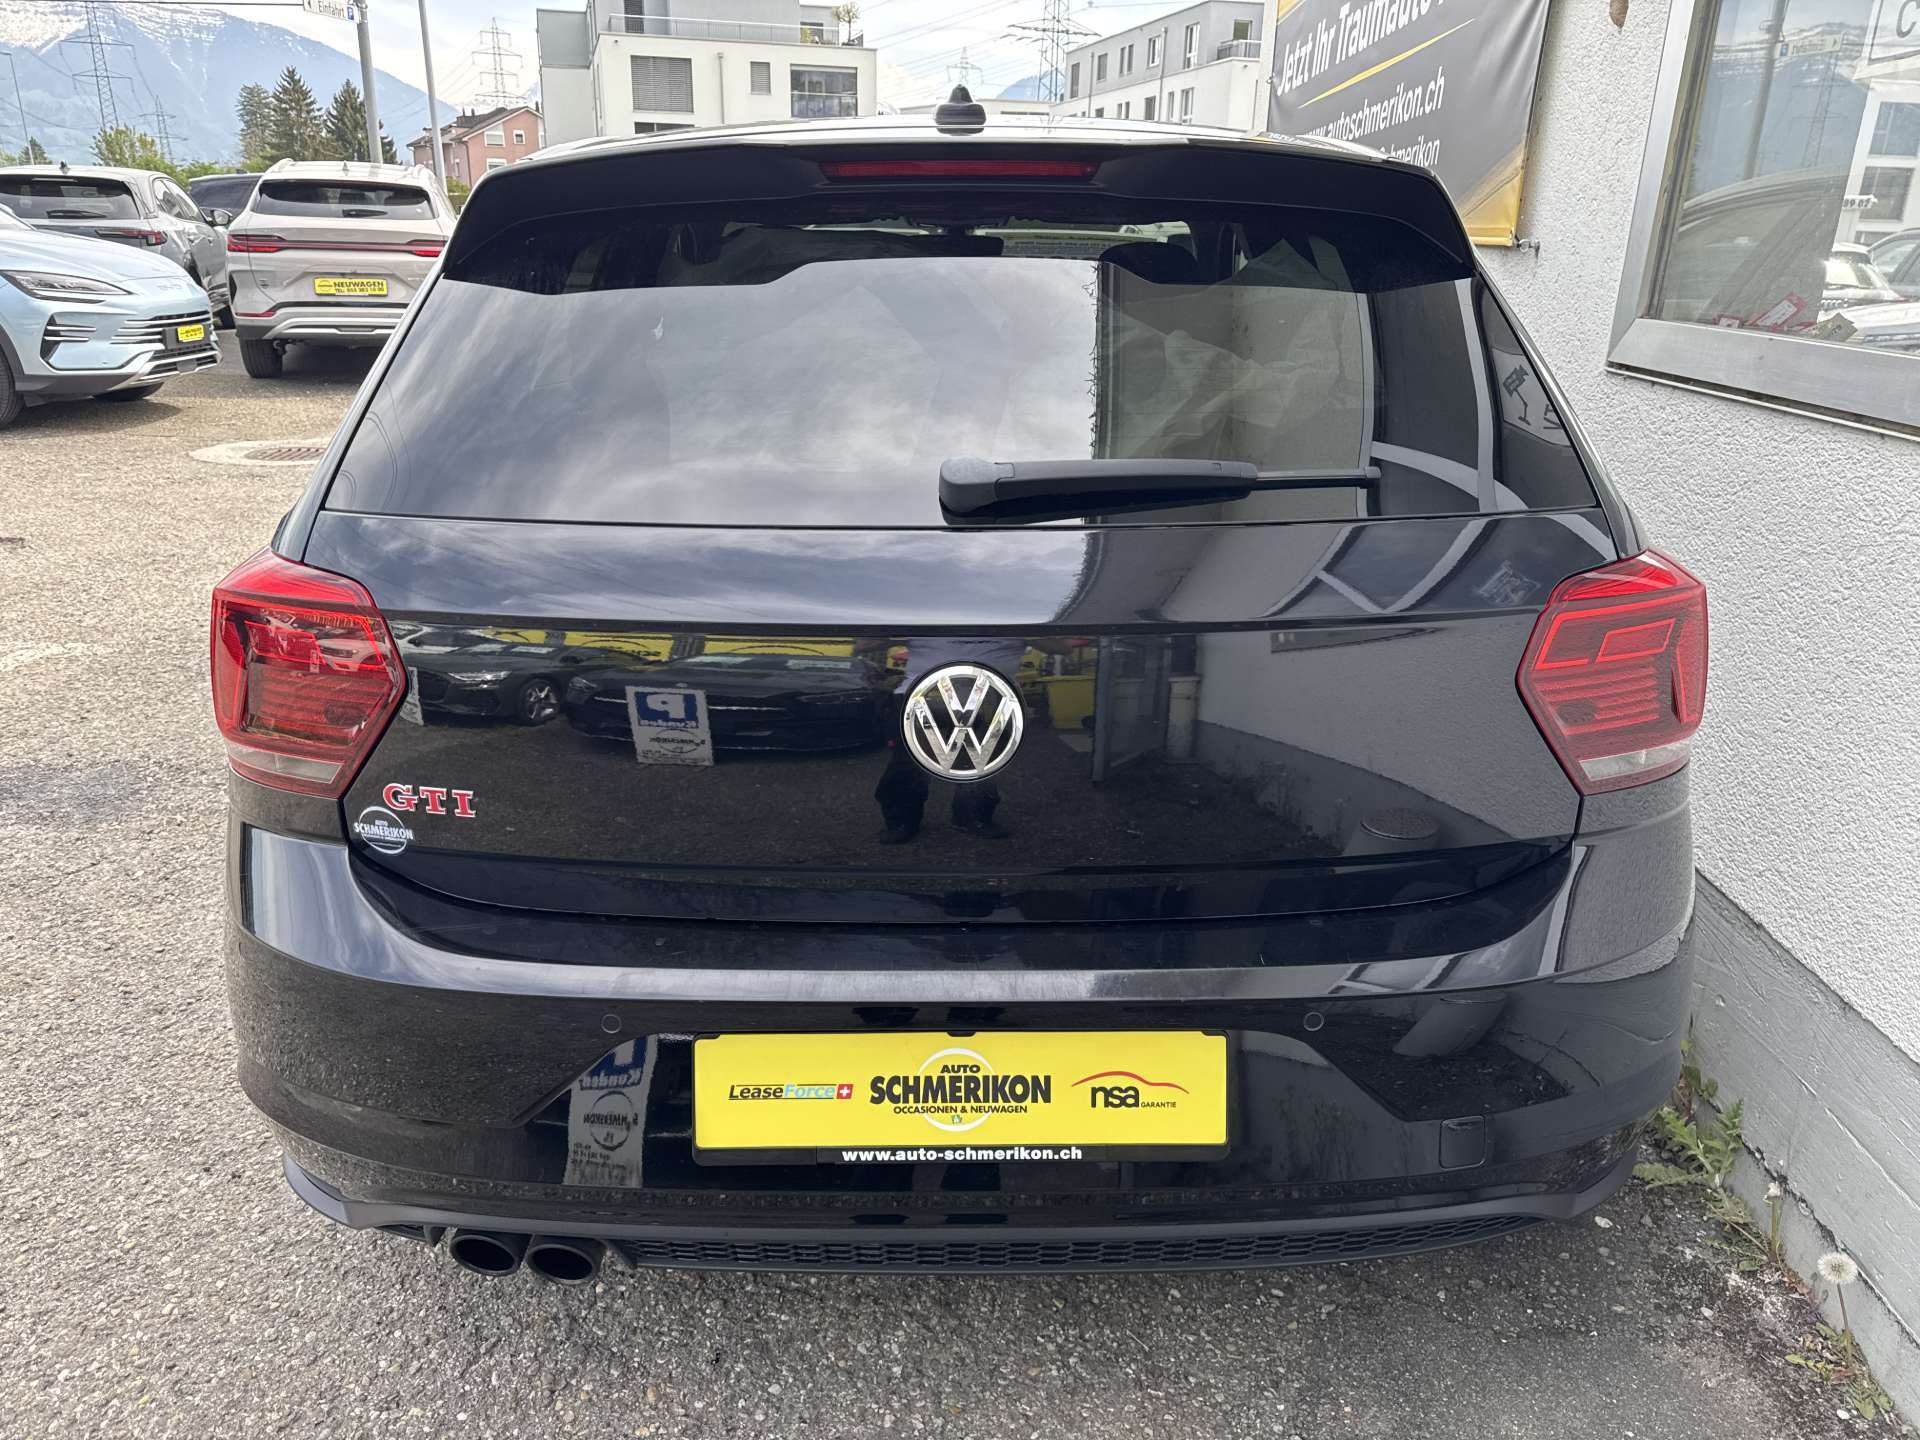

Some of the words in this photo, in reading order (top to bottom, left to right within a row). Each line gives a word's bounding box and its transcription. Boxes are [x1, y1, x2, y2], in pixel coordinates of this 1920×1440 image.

[1277, 32, 1313, 97] Jetzt
[1311, 18, 1336, 78] Ihr
[1304, 66, 1445, 141] wwautoschmerikon.ch
[1380, 135, 1440, 167] hmerikon
[383, 783, 477, 818] GTI
[353, 822, 414, 840] SCHMERIKON
[941, 1064, 980, 1074] AUTO
[729, 1084, 835, 1100] LeaseForce
[870, 1075, 1052, 1105] SCHMERIKON
[1091, 1086, 1139, 1108] nsa
[893, 1105, 957, 1114] OCCASIONEN
[960, 1105, 968, 1113] &
[970, 1105, 1027, 1113] NEUWAGEN
[842, 1147, 1082, 1161] www.auto-schmerikon.ch
